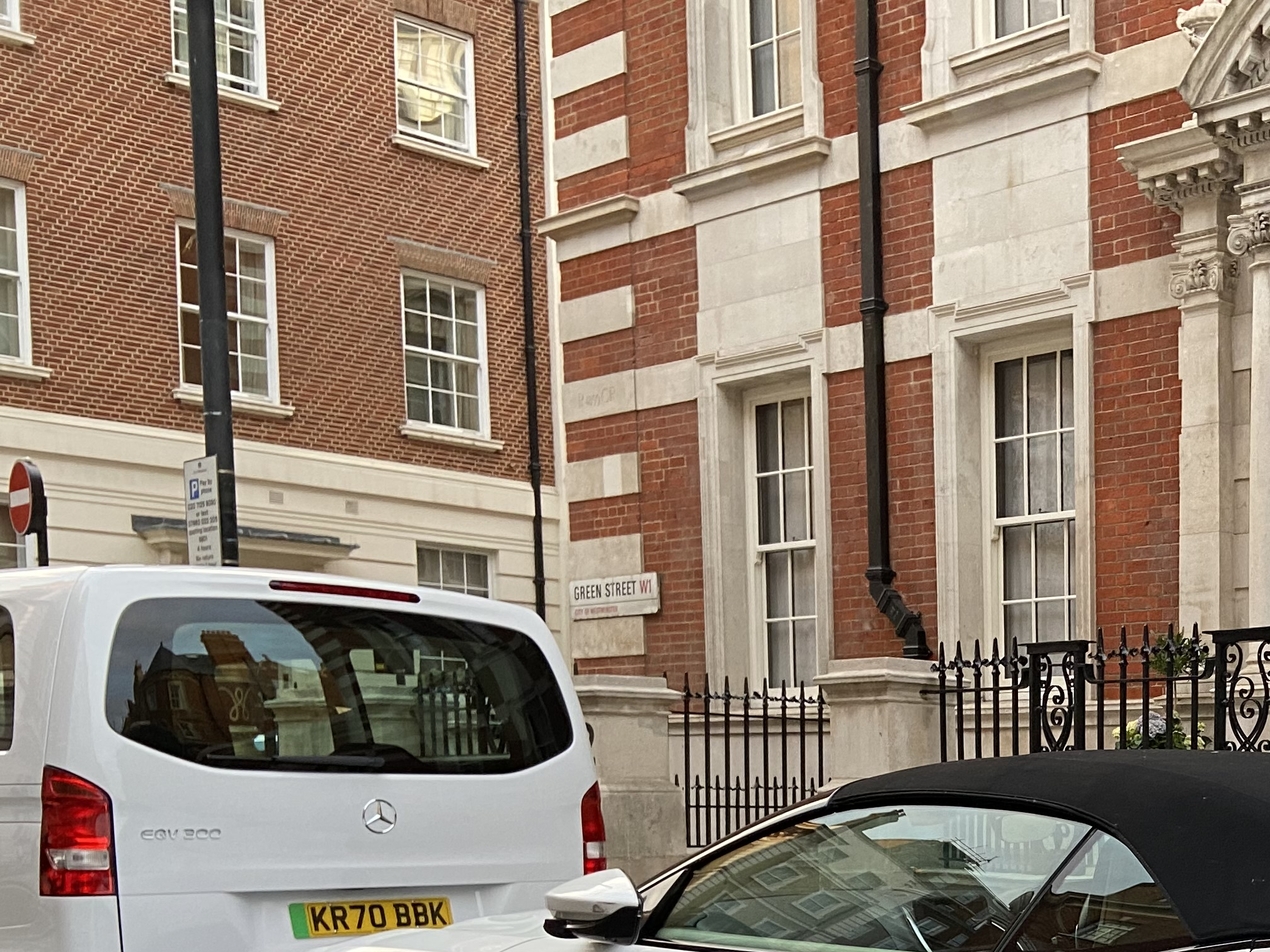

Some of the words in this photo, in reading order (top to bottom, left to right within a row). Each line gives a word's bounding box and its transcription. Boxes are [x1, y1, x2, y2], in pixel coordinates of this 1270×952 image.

[574, 584, 602, 601] GREEN
[605, 581, 636, 598] STREET
[640, 579, 652, 594] W1
[140, 829, 179, 841] EQV
[183, 828, 222, 841] 300
[310, 904, 387, 932] KR70
[393, 901, 447, 927] BBK
